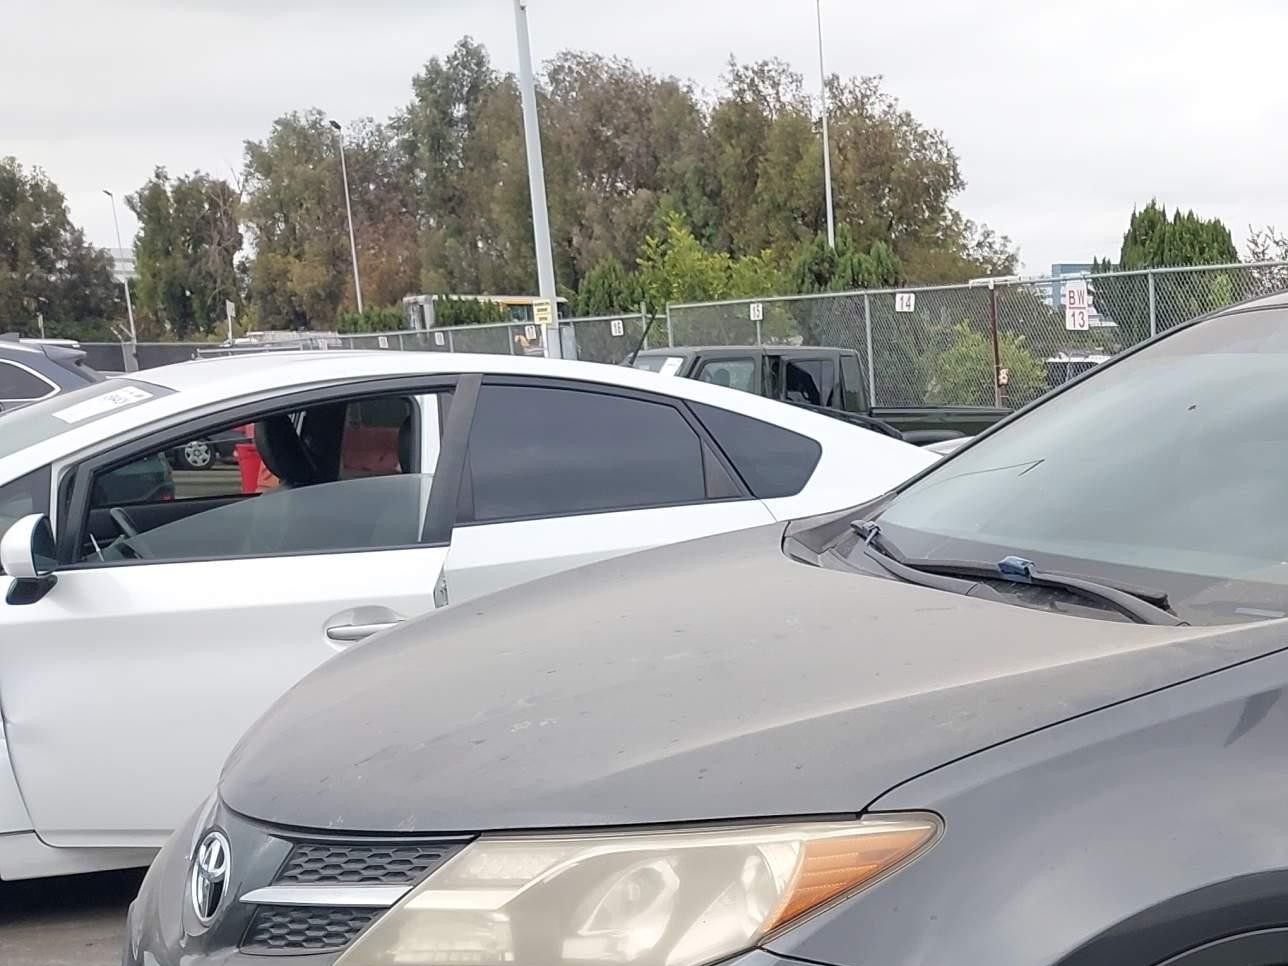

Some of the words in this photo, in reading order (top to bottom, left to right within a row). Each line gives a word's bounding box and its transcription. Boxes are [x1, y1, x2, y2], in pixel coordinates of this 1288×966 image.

[899, 295, 912, 310] 14
[1068, 289, 1085, 306] BW
[1071, 311, 1086, 328] 13
